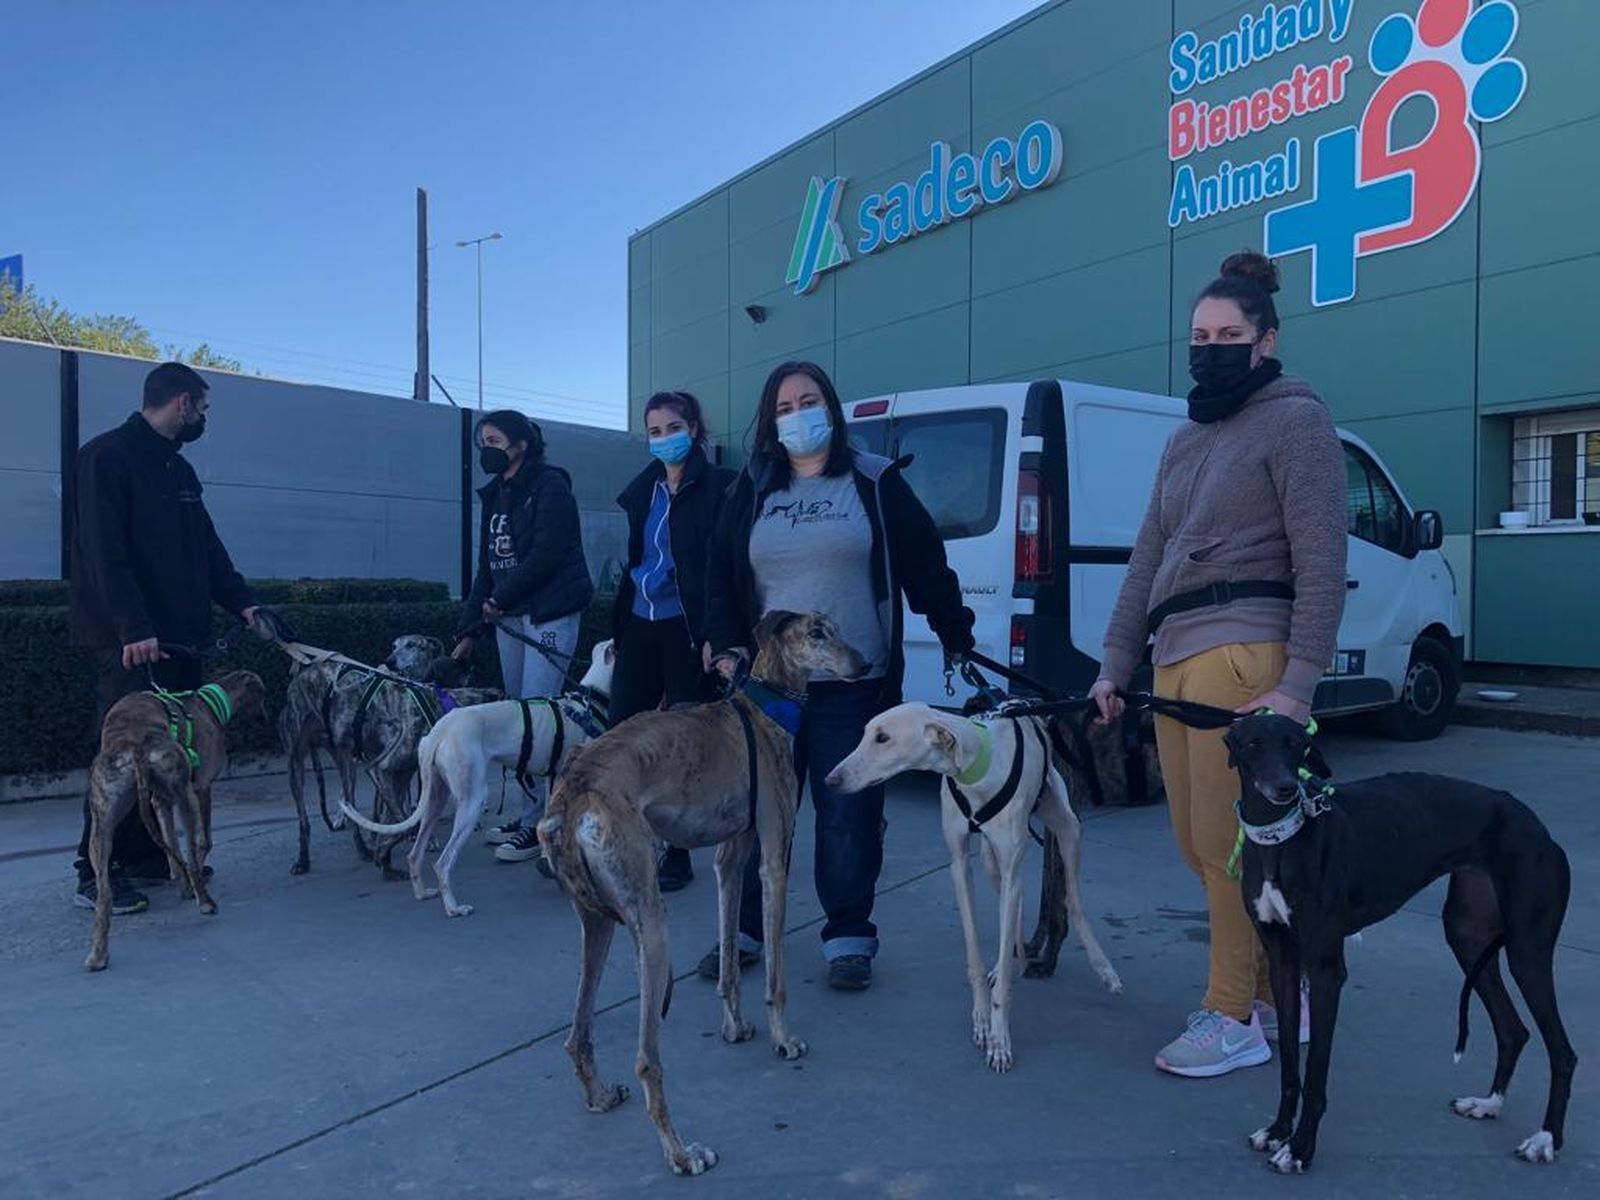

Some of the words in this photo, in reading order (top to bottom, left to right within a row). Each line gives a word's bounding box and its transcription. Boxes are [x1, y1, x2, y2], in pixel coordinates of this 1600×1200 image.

[1169, 0, 1323, 94] Sanidad
[1329, 0, 1352, 42] y
[1169, 55, 1351, 161] Bienestar
[857, 119, 1062, 254] sadeco
[1168, 137, 1299, 227] Animal
